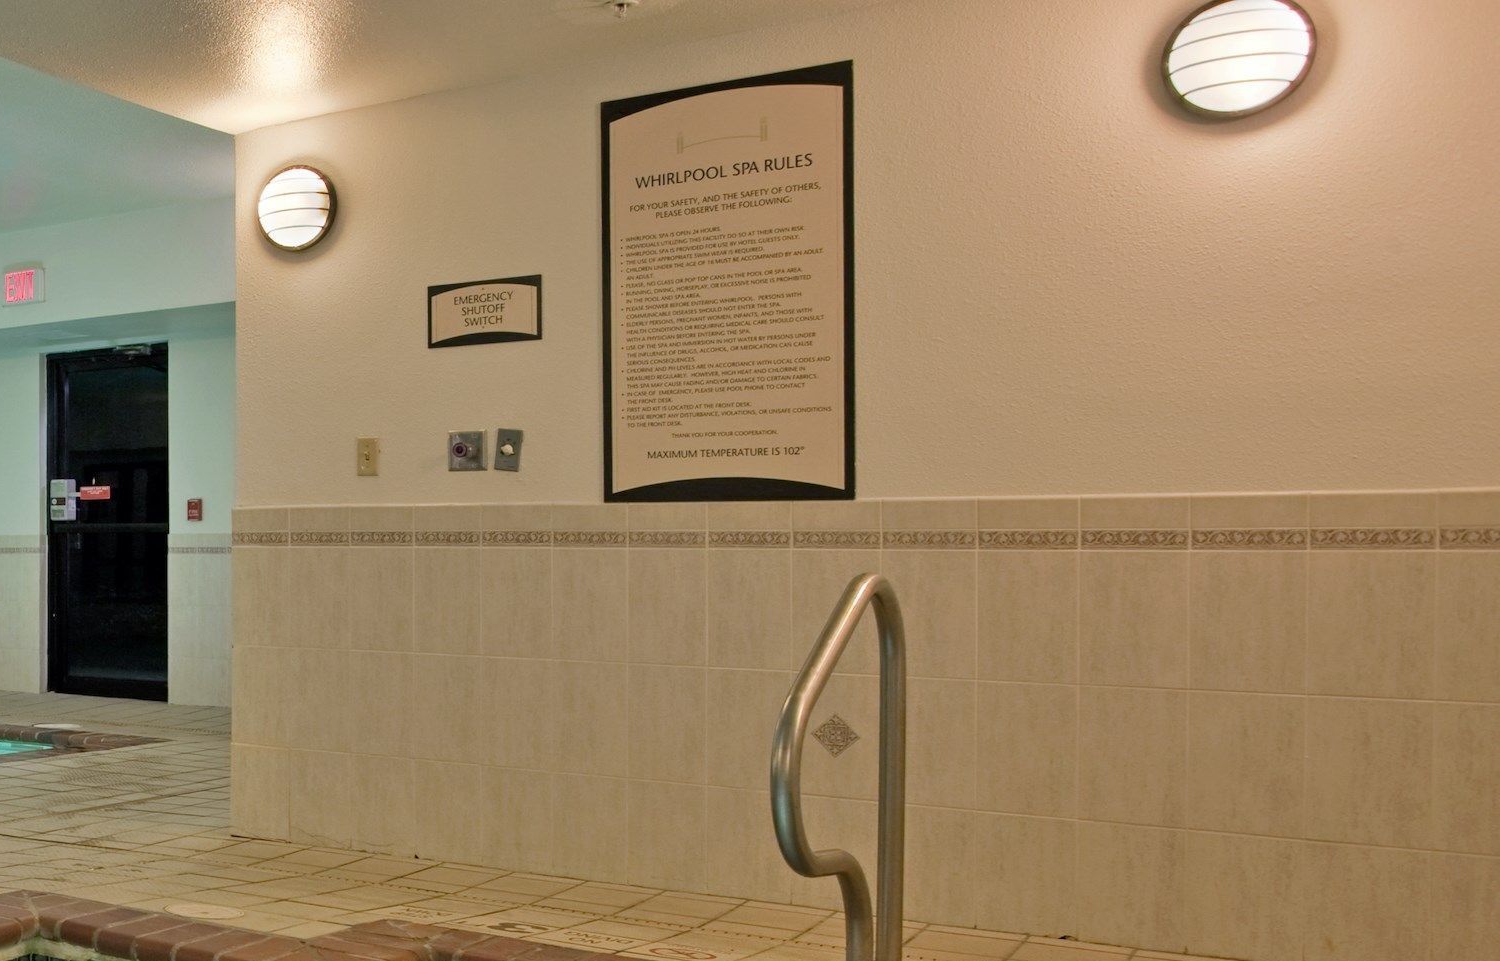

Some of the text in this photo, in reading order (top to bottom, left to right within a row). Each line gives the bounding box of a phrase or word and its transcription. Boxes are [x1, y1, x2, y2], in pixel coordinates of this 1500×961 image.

[634, 152, 813, 189] WHIRLPOOL SPA RULES
[629, 180, 821, 212] FOR YOUR SAFETY, AND THE SAFETY OF OTHERS,
[654, 194, 793, 219] PLEASE OBSERVE THE FOLLOWING:
[5, 269, 36, 303] EXIT
[453, 290, 514, 306] EMERGENCY
[461, 303, 505, 316] SHUTOFF
[464, 314, 503, 328] SWITCH
[646, 449, 697, 459] MAXIMUM
[700, 447, 768, 457] TEMPERATURE
[771, 447, 780, 455] IS
